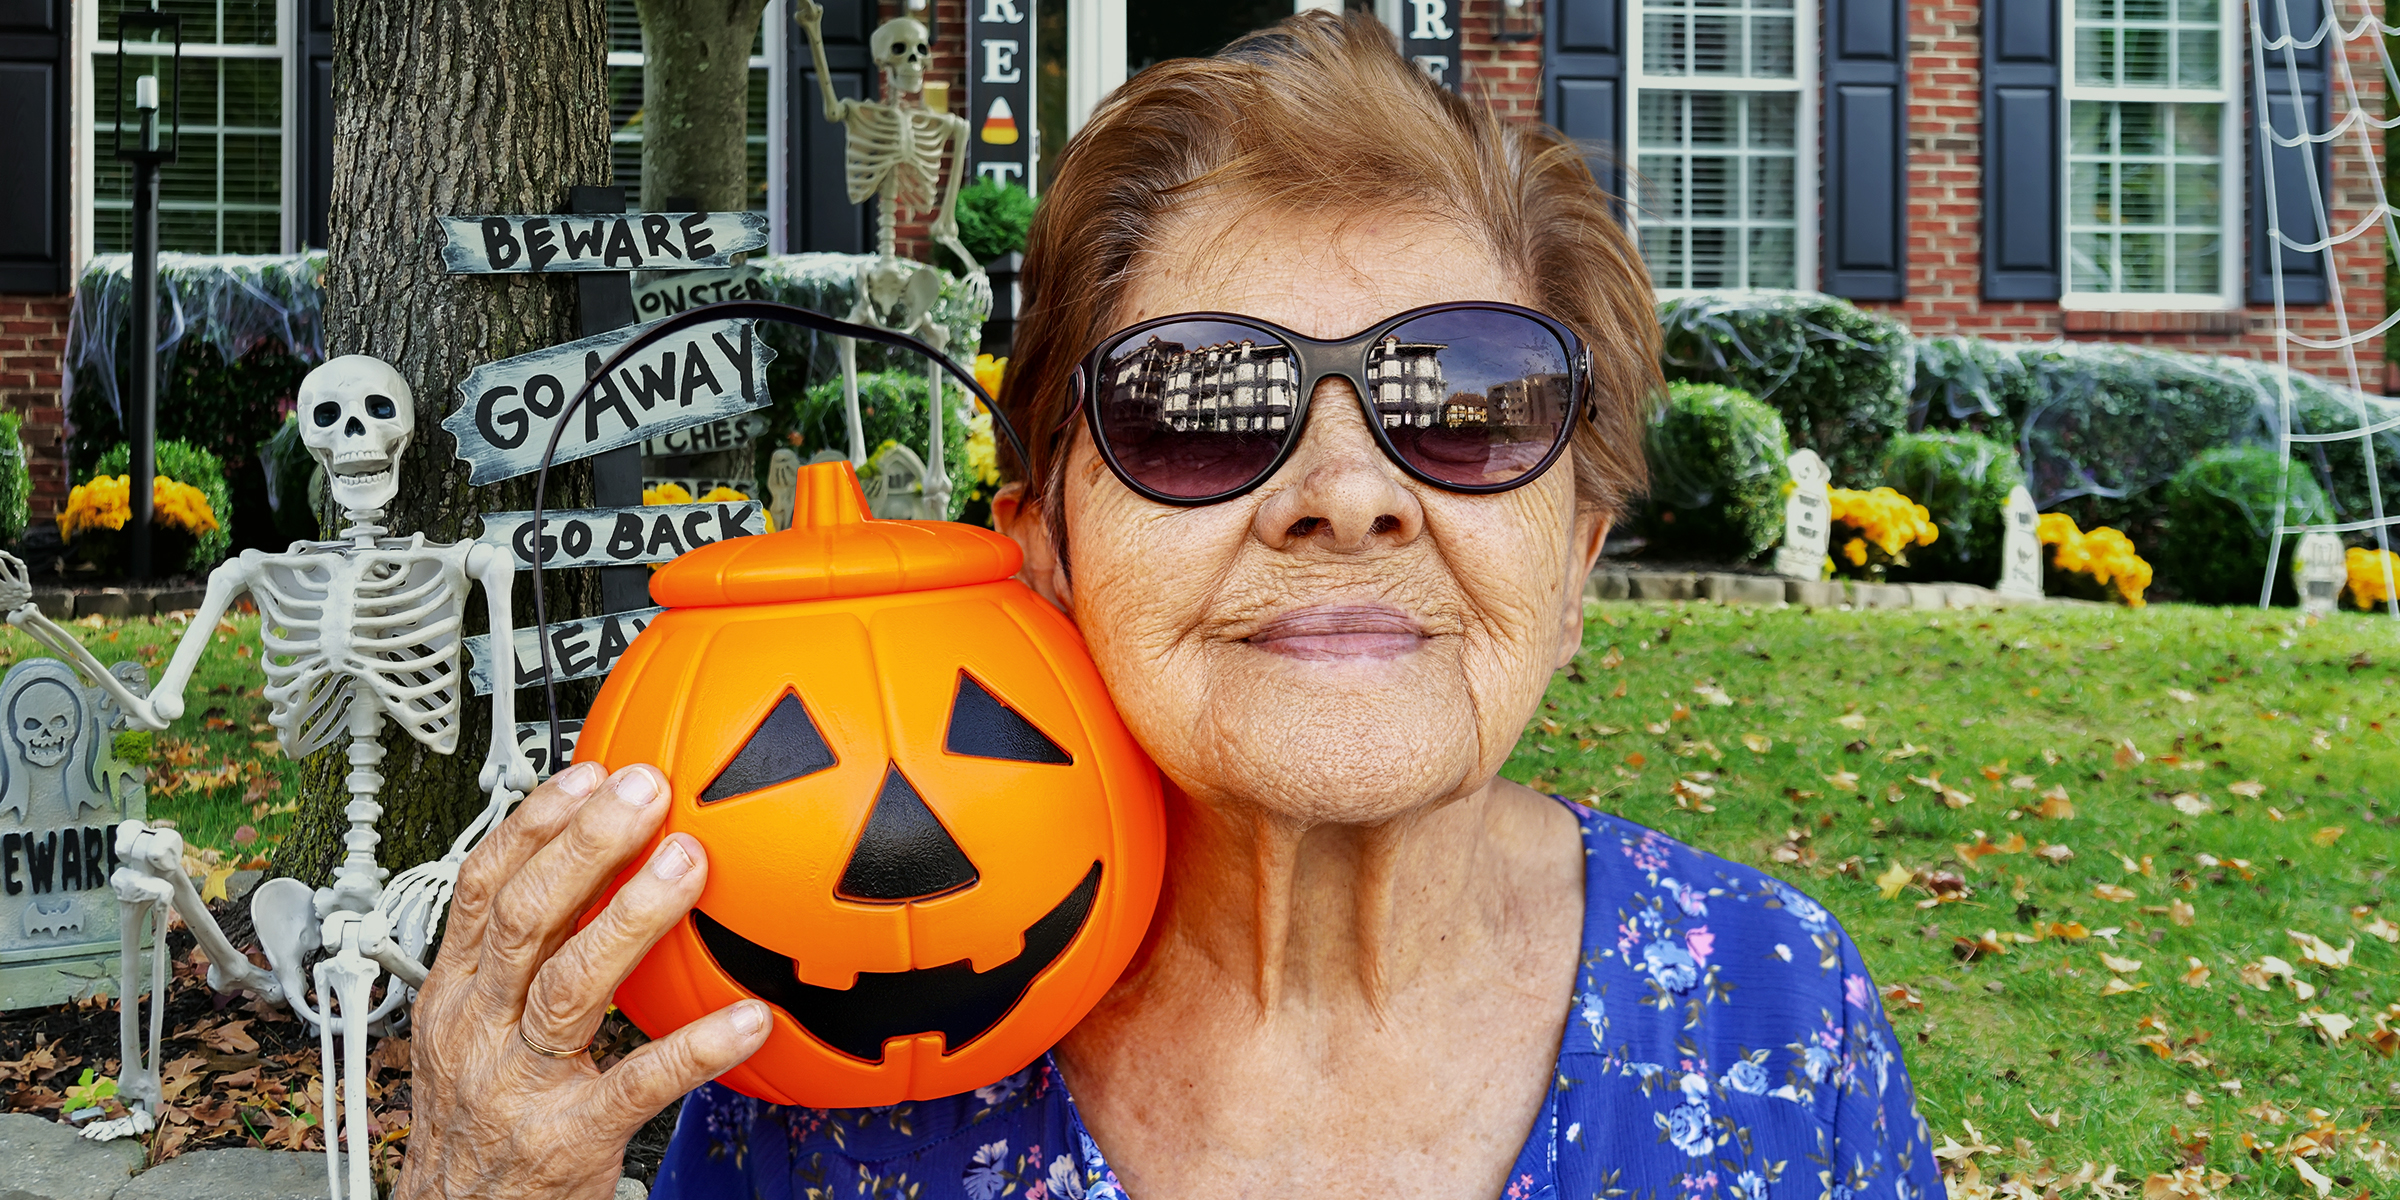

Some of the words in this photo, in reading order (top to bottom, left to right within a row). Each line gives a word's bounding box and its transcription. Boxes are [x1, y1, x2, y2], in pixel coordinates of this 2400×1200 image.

[481, 211, 717, 272] BEWARE
[475, 373, 565, 450] GO
[584, 324, 757, 443] AWAY
[511, 518, 593, 563] GO
[605, 503, 754, 560] BACK
